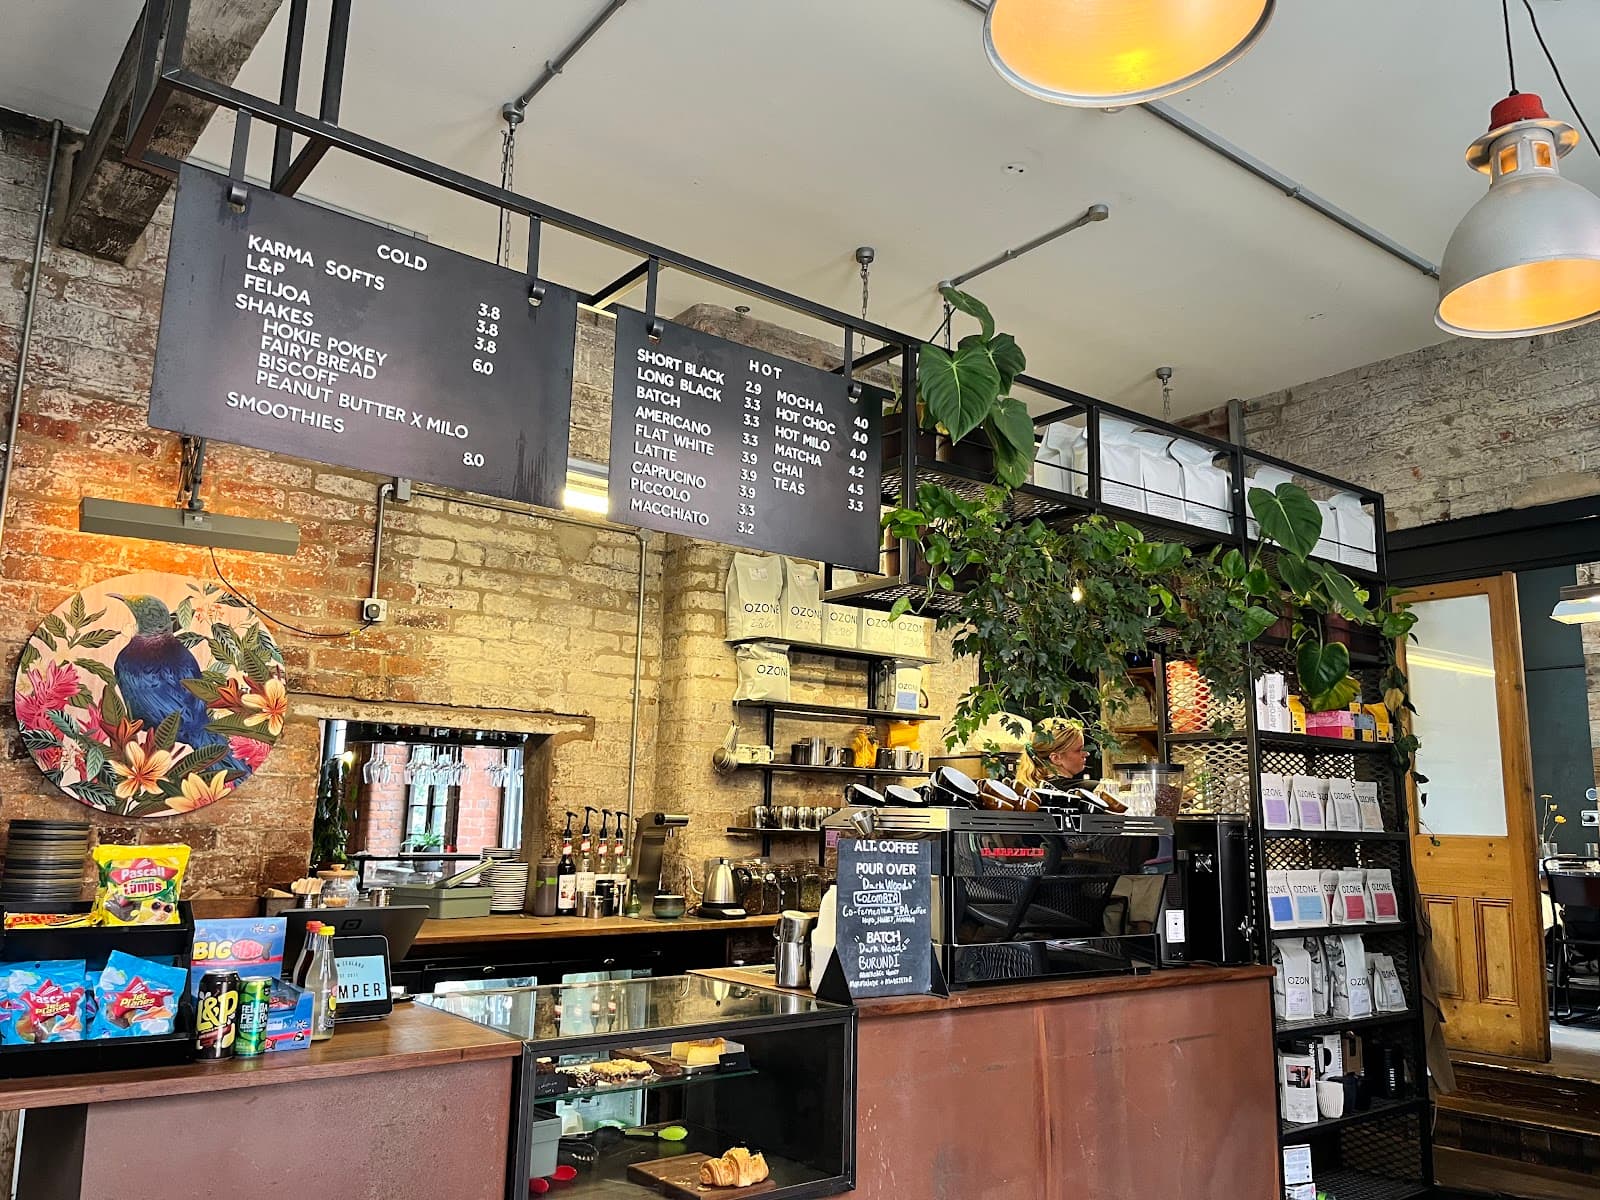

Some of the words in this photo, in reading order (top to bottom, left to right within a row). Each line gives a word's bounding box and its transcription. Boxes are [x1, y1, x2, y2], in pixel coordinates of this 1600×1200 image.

[246, 254, 286, 277] L&P
[247, 234, 315, 268] KARMA
[325, 259, 386, 291] SOFTS
[377, 245, 427, 270] COLD
[243, 274, 311, 306] FEIJOA
[235, 294, 314, 327] SHAKES
[478, 303, 501, 321] 3.8
[475, 319, 499, 337] 3.8
[263, 319, 322, 349] HOKIE
[327, 336, 389, 367] POKEY
[473, 336, 497, 354] 3.8
[260, 335, 315, 362] FAIRY
[315, 350, 377, 380] BREAD
[472, 358, 494, 375] 6.0
[637, 348, 683, 372] SHORT
[684, 361, 725, 385] BLACK
[257, 352, 340, 386] BISCOFF
[749, 359, 783, 380] HOT
[637, 366, 675, 387] LONG
[679, 378, 722, 402] BLACK
[745, 380, 762, 395] 2.9
[255, 370, 335, 403] PEANUT
[337, 392, 406, 423] BUTTER
[409, 411, 424, 428] X
[426, 416, 470, 439] MILO
[636, 385, 681, 409] BATCH
[743, 397, 761, 411] 3.3
[776, 389, 824, 415] MOCHA
[226, 391, 346, 434] SMOOTHIES
[635, 405, 712, 437] AMERICANO
[743, 413, 760, 428] 3.3
[775, 406, 800, 424] HOT
[802, 415, 836, 435] CHOC
[853, 416, 869, 430] 4.0
[635, 423, 669, 442] FLAT
[673, 433, 715, 456] WHITE
[742, 432, 759, 447] 3.3
[774, 424, 800, 443] HOT
[802, 434, 831, 452] MILO
[852, 431, 868, 445] 4.0
[634, 440, 677, 463] LATTE
[741, 450, 758, 465] 3.9
[774, 442, 823, 467] MATCHA
[849, 448, 867, 462] 4.0
[631, 460, 707, 490] CAPPUCINO
[740, 468, 758, 482] 3.9
[772, 461, 803, 479] CHAI
[848, 465, 865, 478] 4.2
[630, 476, 691, 503] PICCOLO
[738, 484, 756, 499] 3.9
[772, 476, 806, 496] TEAS
[847, 483, 864, 496] 4.5
[630, 497, 710, 527] MACCHIATO
[737, 502, 756, 517] 3.3
[847, 498, 864, 512] 3.3
[737, 520, 755, 535] 3.2
[866, 617, 895, 630] OZON
[756, 664, 788, 677] OZON
[854, 839, 878, 852] ALT.
[879, 840, 919, 854] COFFEE
[120, 866, 166, 881] Pascall
[856, 862, 884, 875] POUR
[886, 863, 917, 876] OVER
[866, 929, 901, 944] BATCH
[192, 941, 233, 960] BIG
[858, 953, 901, 970] BURUNDI
[1287, 976, 1310, 986] OZON
[1350, 977, 1365, 987] OZO
[338, 982, 381, 1000] MPER
[196, 990, 239, 1032] L&P
